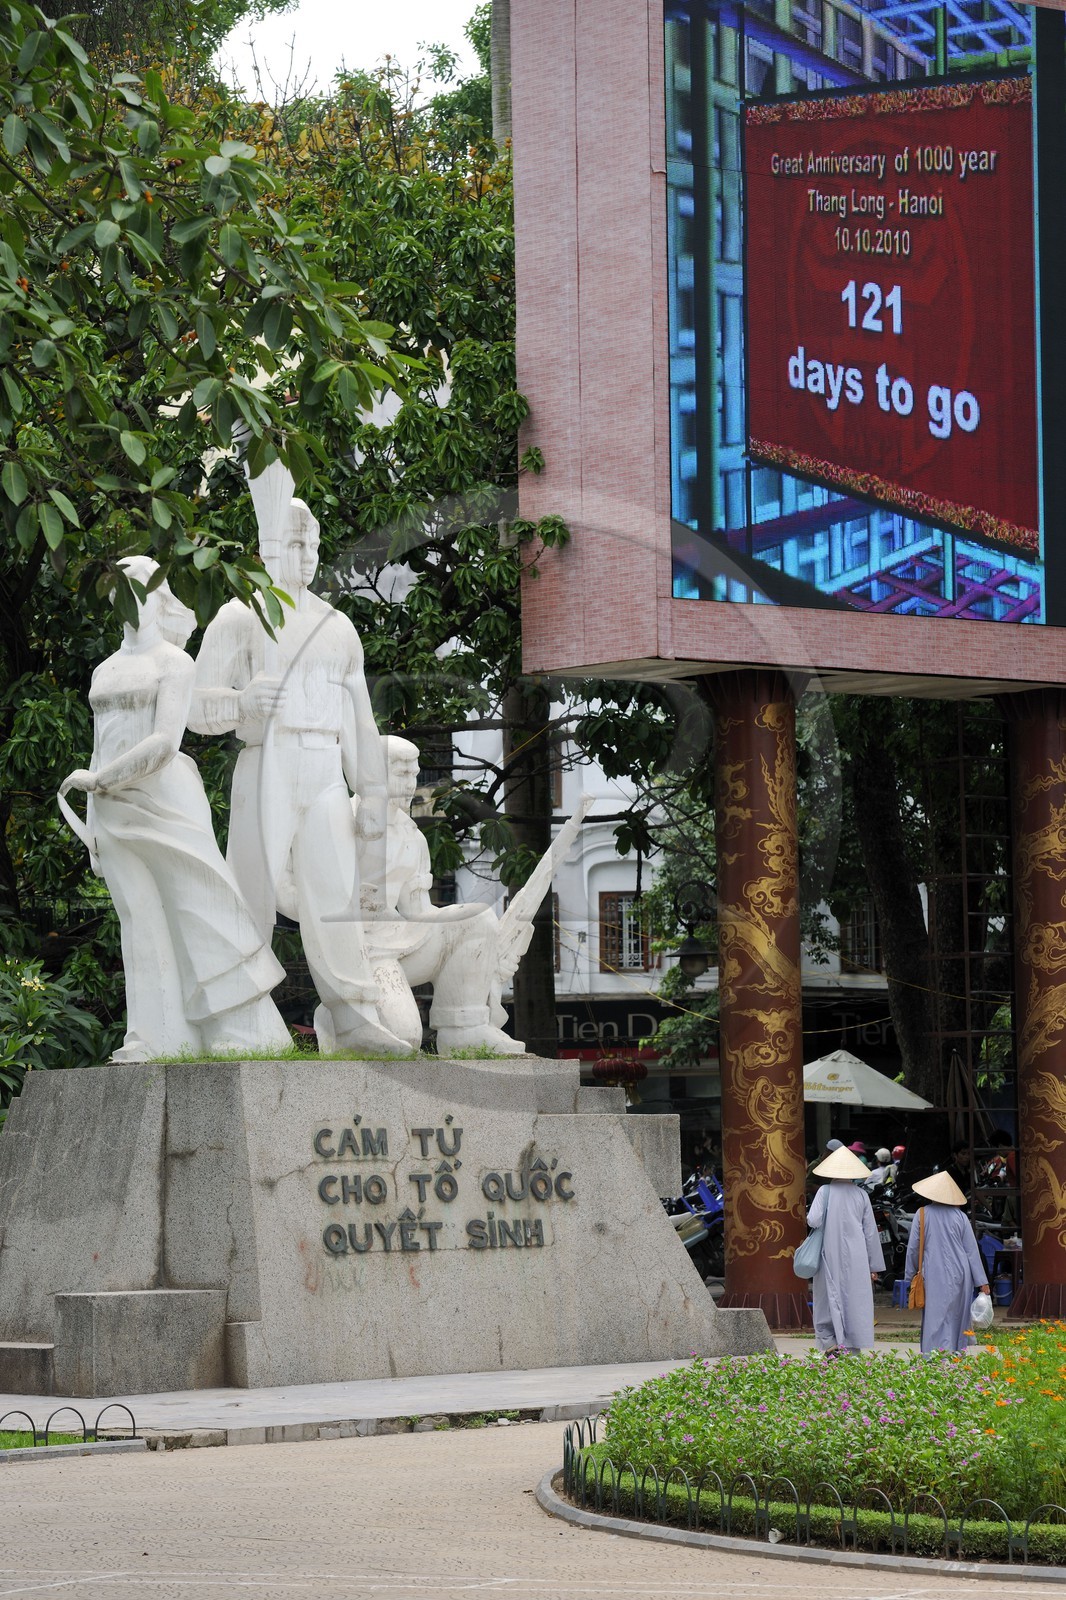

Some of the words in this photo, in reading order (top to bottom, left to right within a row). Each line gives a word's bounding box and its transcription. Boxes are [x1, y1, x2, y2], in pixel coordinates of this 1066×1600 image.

[770, 152, 803, 174] Great
[807, 151, 885, 179] Anniversary
[894, 147, 909, 173] of
[915, 146, 953, 172] 1000
[959, 150, 997, 178] year
[807, 188, 847, 218] Thang
[851, 189, 884, 219] Long
[898, 188, 943, 215] Hanoi
[834, 226, 911, 255] 10.10.2010
[841, 280, 903, 334] 121
[788, 346, 864, 410] days
[875, 363, 914, 416] to
[927, 384, 981, 438] go
[555, 1013, 618, 1042] Tien
[313, 1113, 389, 1157] CẢM
[318, 1174, 388, 1205] CHO
[409, 1160, 462, 1203] TỔ
[482, 1157, 576, 1205] QUỐC
[322, 1206, 443, 1253] QUYẾT
